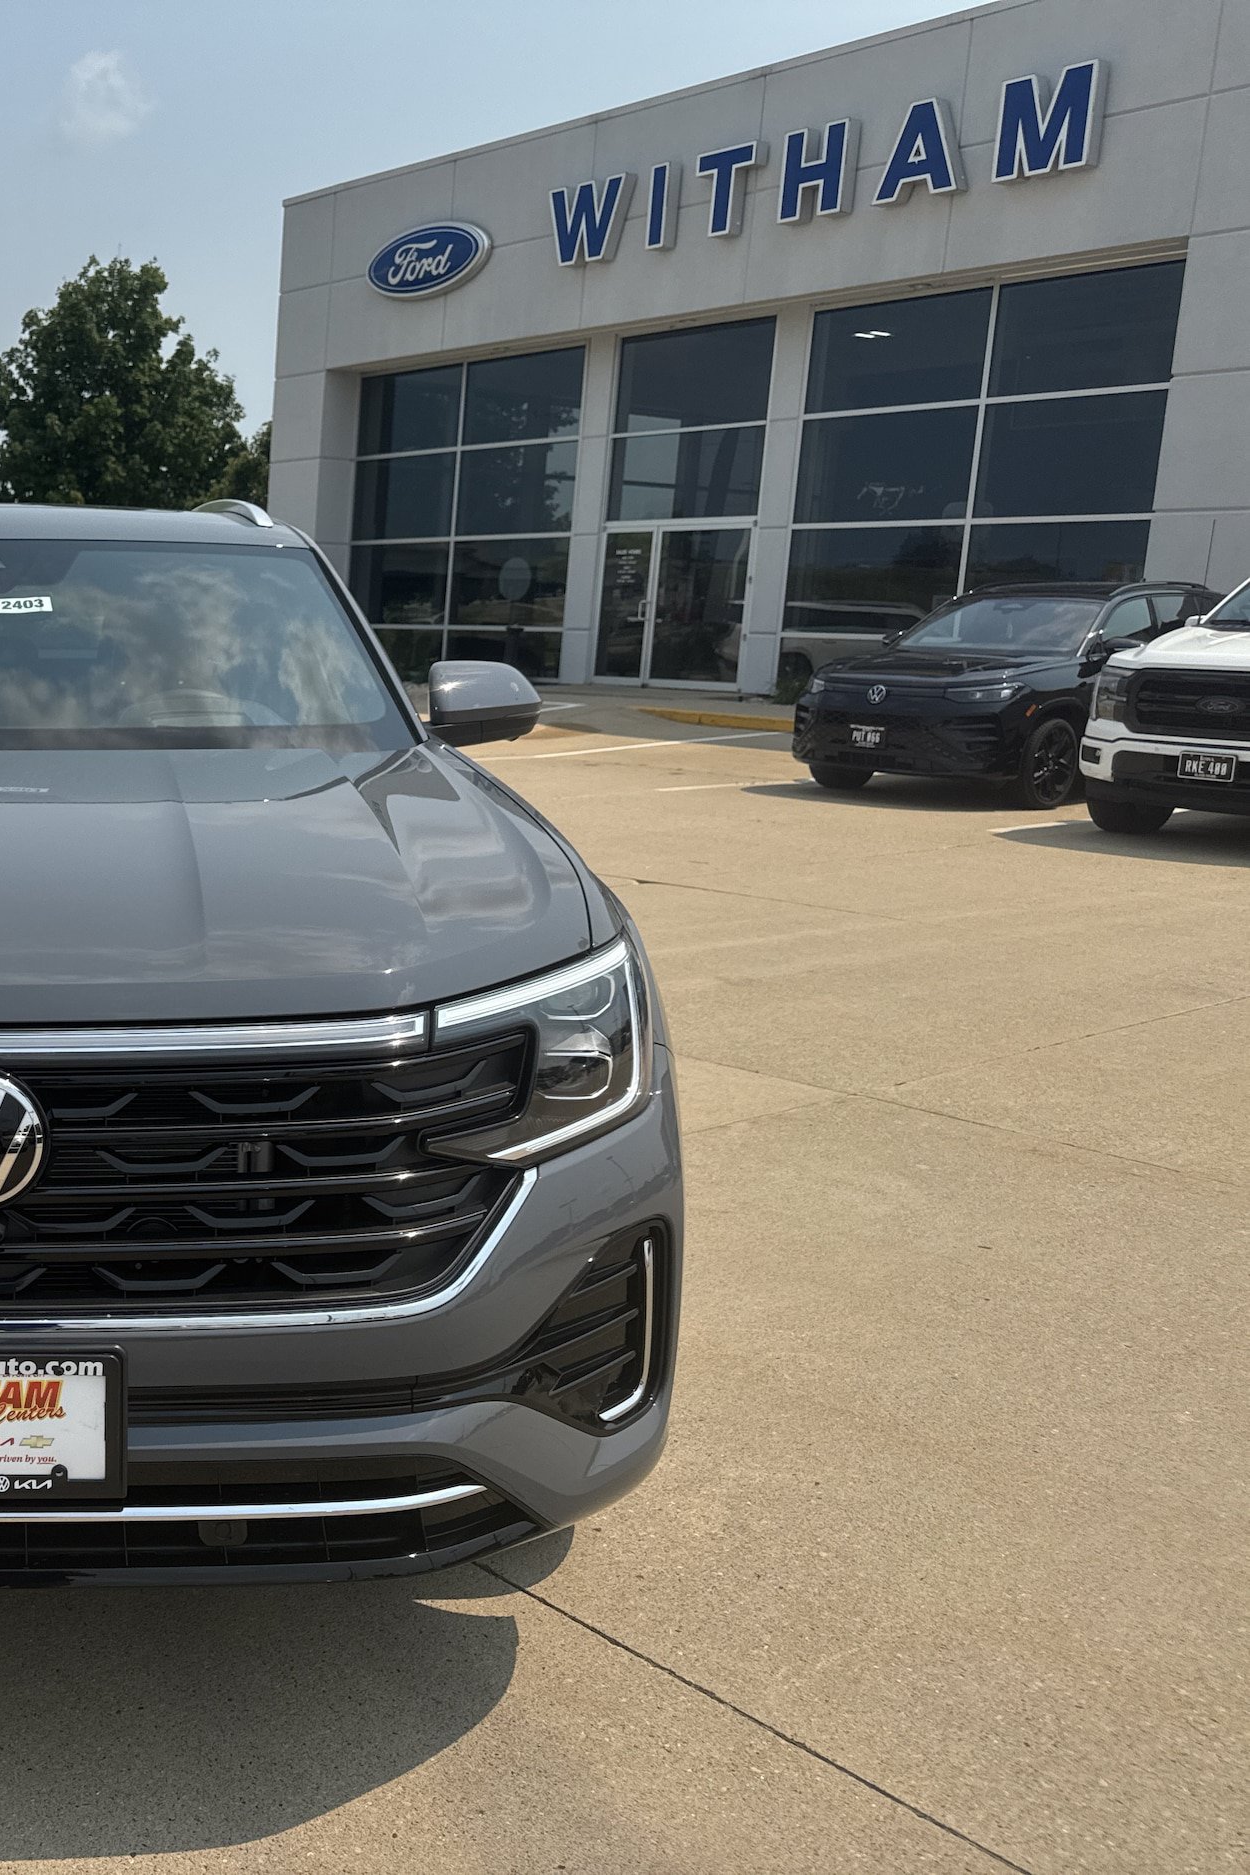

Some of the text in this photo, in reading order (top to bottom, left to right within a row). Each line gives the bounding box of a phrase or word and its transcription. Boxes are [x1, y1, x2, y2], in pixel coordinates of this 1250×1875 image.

[550, 58, 1107, 267] WITHAM
[1, 598, 45, 610] 2403
[1184, 759, 1206, 774] RKE
[25, 1454, 37, 1465] by
[37, 1456, 57, 1465] you.
